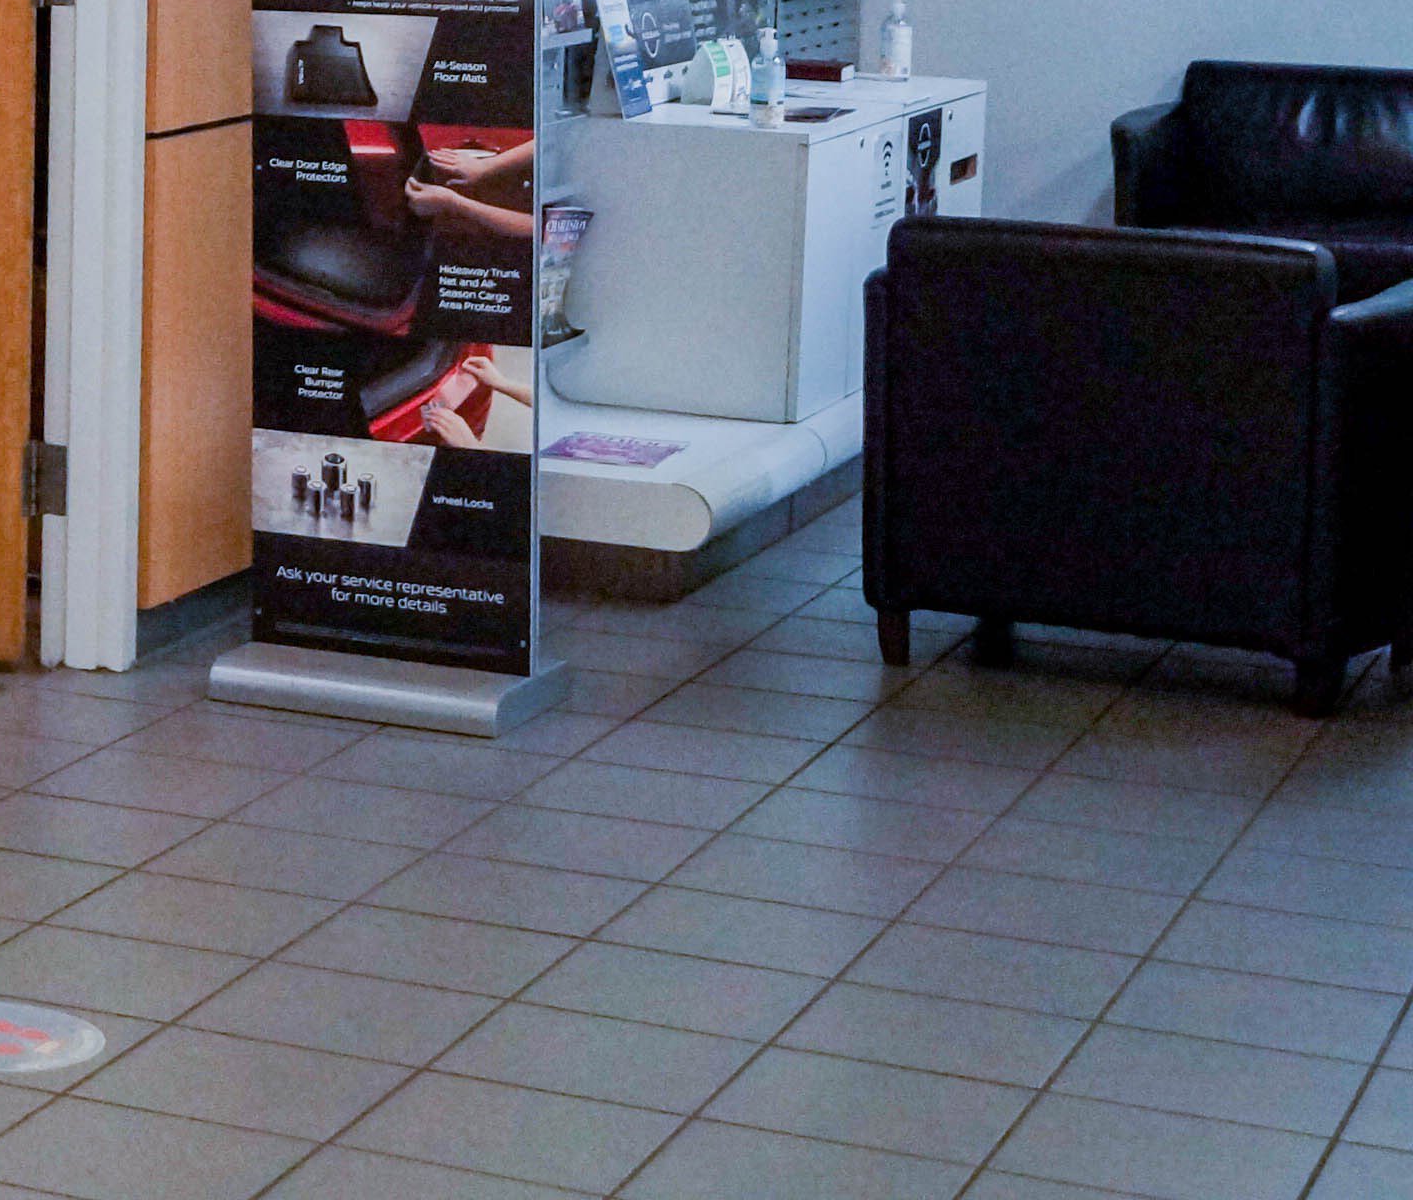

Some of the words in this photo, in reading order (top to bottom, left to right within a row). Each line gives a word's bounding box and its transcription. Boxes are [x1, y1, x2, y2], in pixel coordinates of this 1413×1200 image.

[432, 60, 487, 72] All-Season
[433, 72, 460, 83] Floor
[461, 73, 488, 84] Mats
[269, 158, 294, 169] Clear
[297, 159, 319, 170] Door
[322, 161, 347, 174] Edge
[296, 171, 347, 184] Protectors
[439, 265, 489, 278] Hideaway
[491, 268, 520, 279] Trunk
[439, 276, 457, 286] Net
[459, 278, 479, 288] and
[439, 287, 476, 299] Season
[478, 291, 510, 303] Cargo
[439, 300, 463, 310] Area
[464, 301, 513, 314] Protector
[294, 364, 319, 376] Clear
[321, 366, 344, 377] Rear
[305, 376, 343, 389] Bumper
[298, 388, 343, 400] Protector
[464, 498, 493, 510] Locks
[276, 565, 303, 581] Ask
[305, 571, 339, 586] your
[341, 574, 392, 592] service
[396, 581, 504, 605] representative
[331, 587, 352, 602] for
[354, 593, 395, 608] more
[398, 594, 448, 614] details
